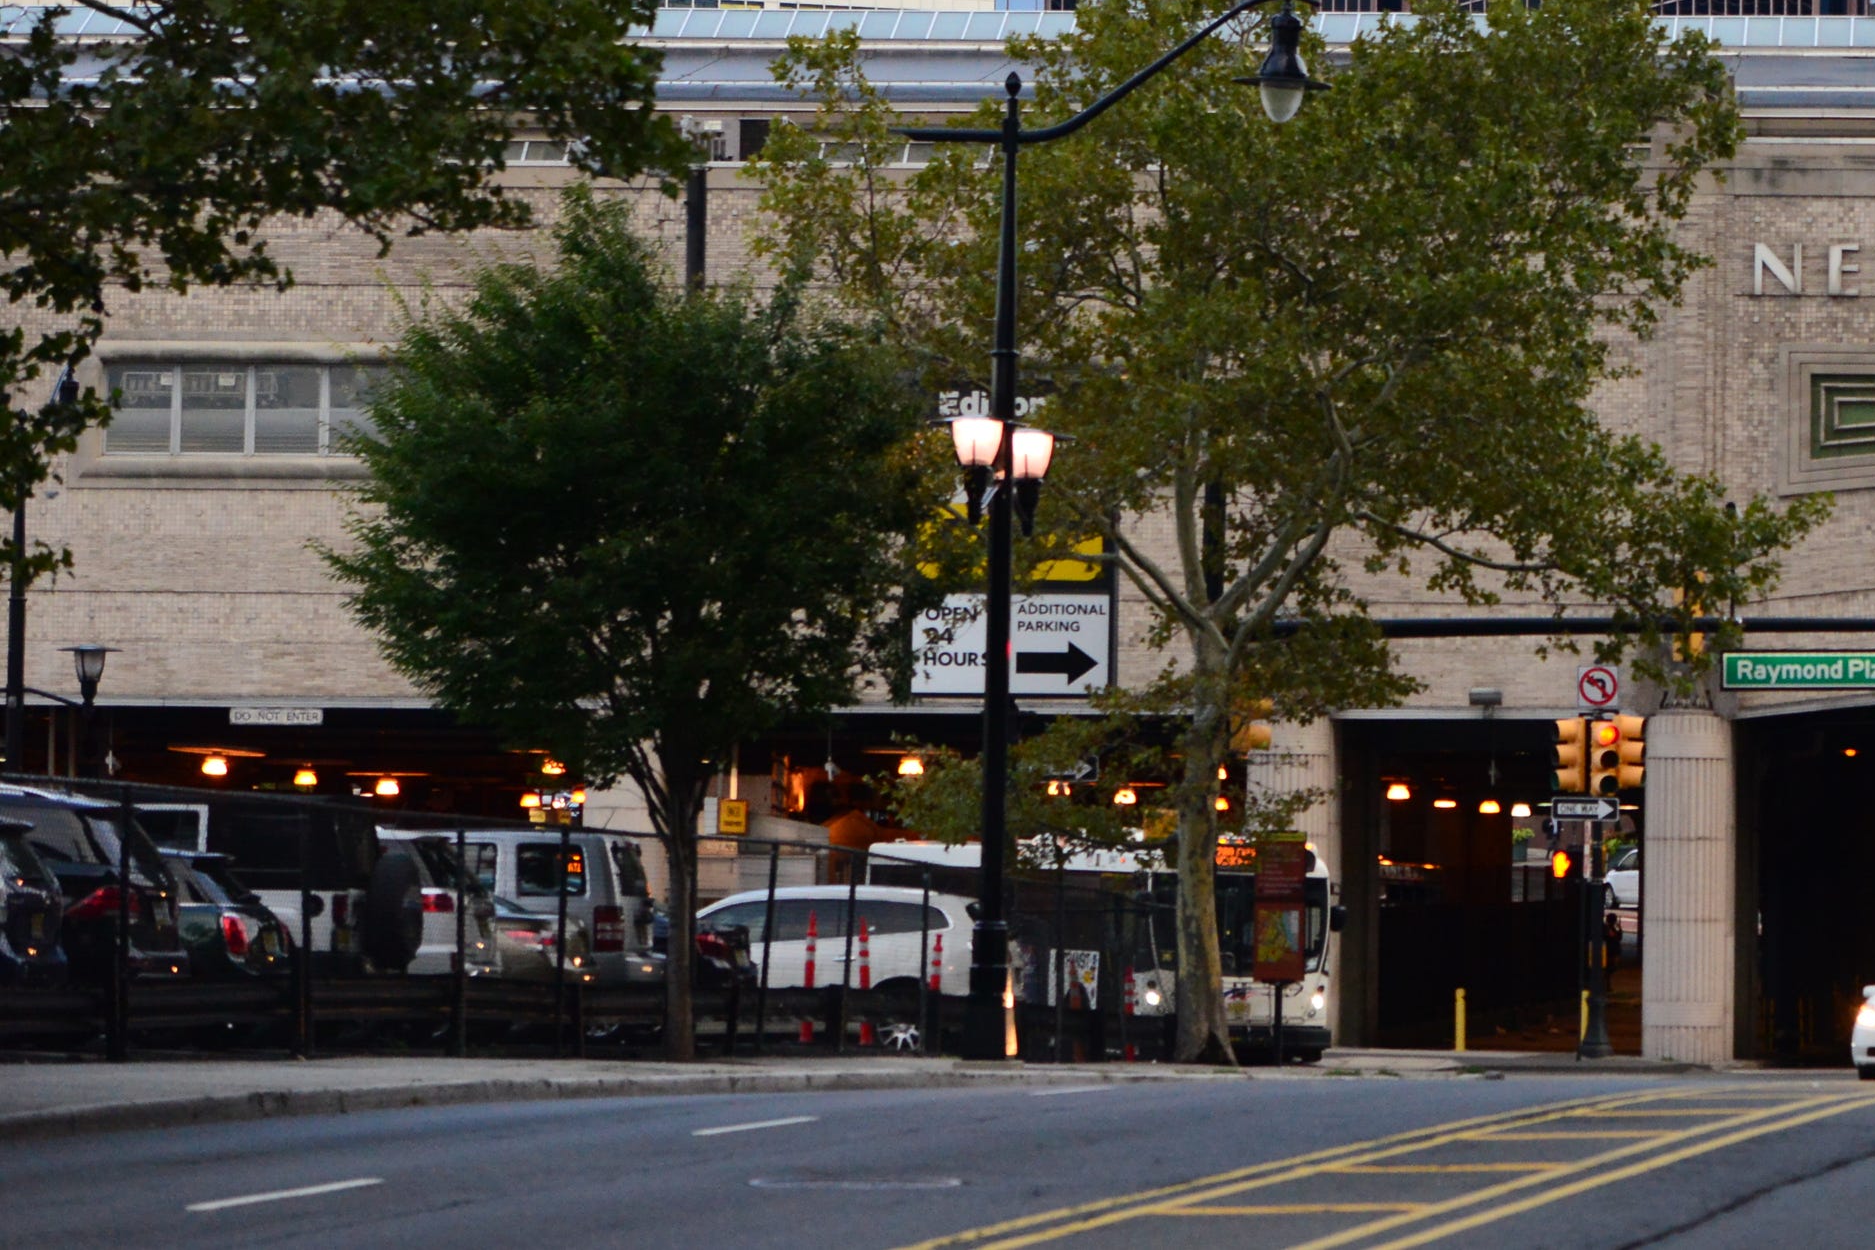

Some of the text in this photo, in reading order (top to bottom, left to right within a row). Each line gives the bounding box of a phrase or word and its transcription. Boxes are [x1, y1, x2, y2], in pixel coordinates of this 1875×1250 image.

[925, 606, 978, 621] OPEN
[1017, 604, 1106, 616] ADDITIONAL
[1017, 621, 1080, 632] PARKING
[925, 627, 954, 645] 24
[1737, 660, 1843, 685] Raymond
[234, 711, 319, 721] DO NOT ENTER
